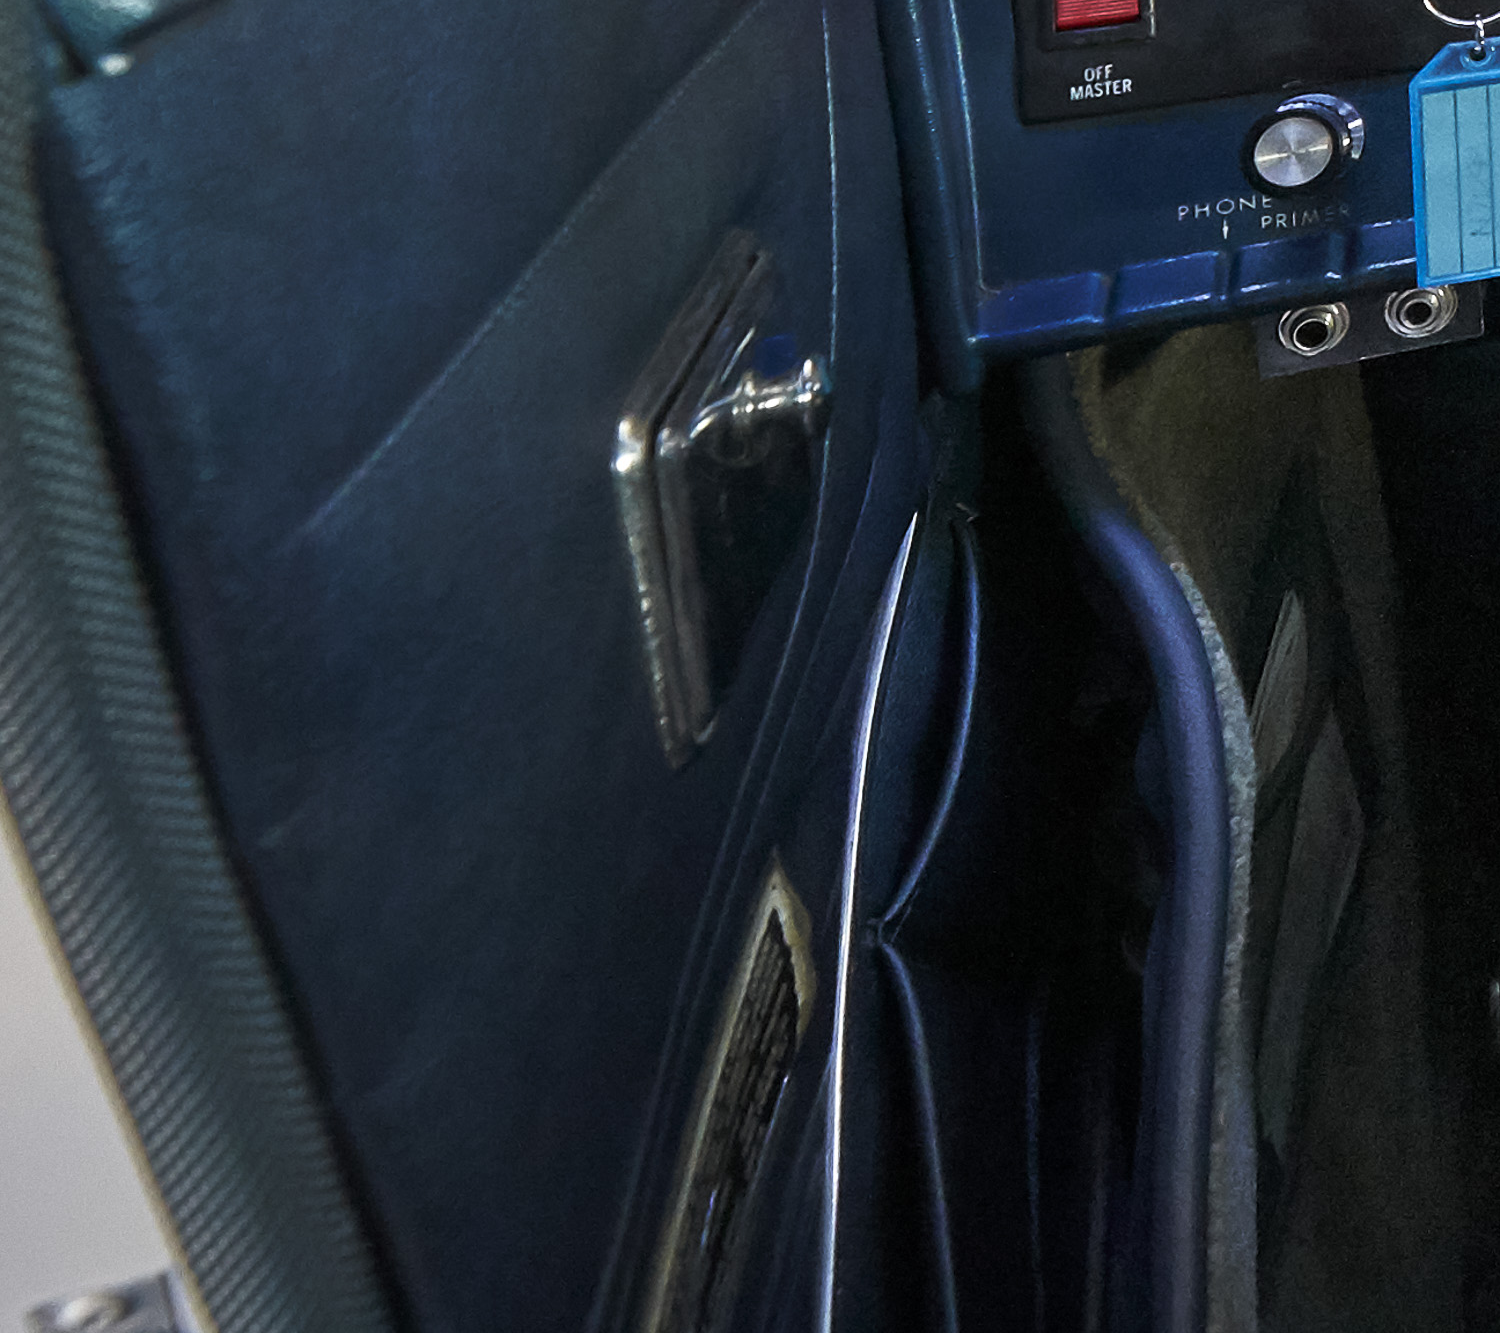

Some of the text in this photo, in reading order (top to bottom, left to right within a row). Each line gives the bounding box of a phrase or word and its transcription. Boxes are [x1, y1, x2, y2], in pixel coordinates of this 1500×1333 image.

[1084, 64, 1114, 82] OFF
[1070, 78, 1132, 101] MASTER
[1177, 194, 1273, 221] PHONE
[1260, 204, 1350, 229] PRIMER
